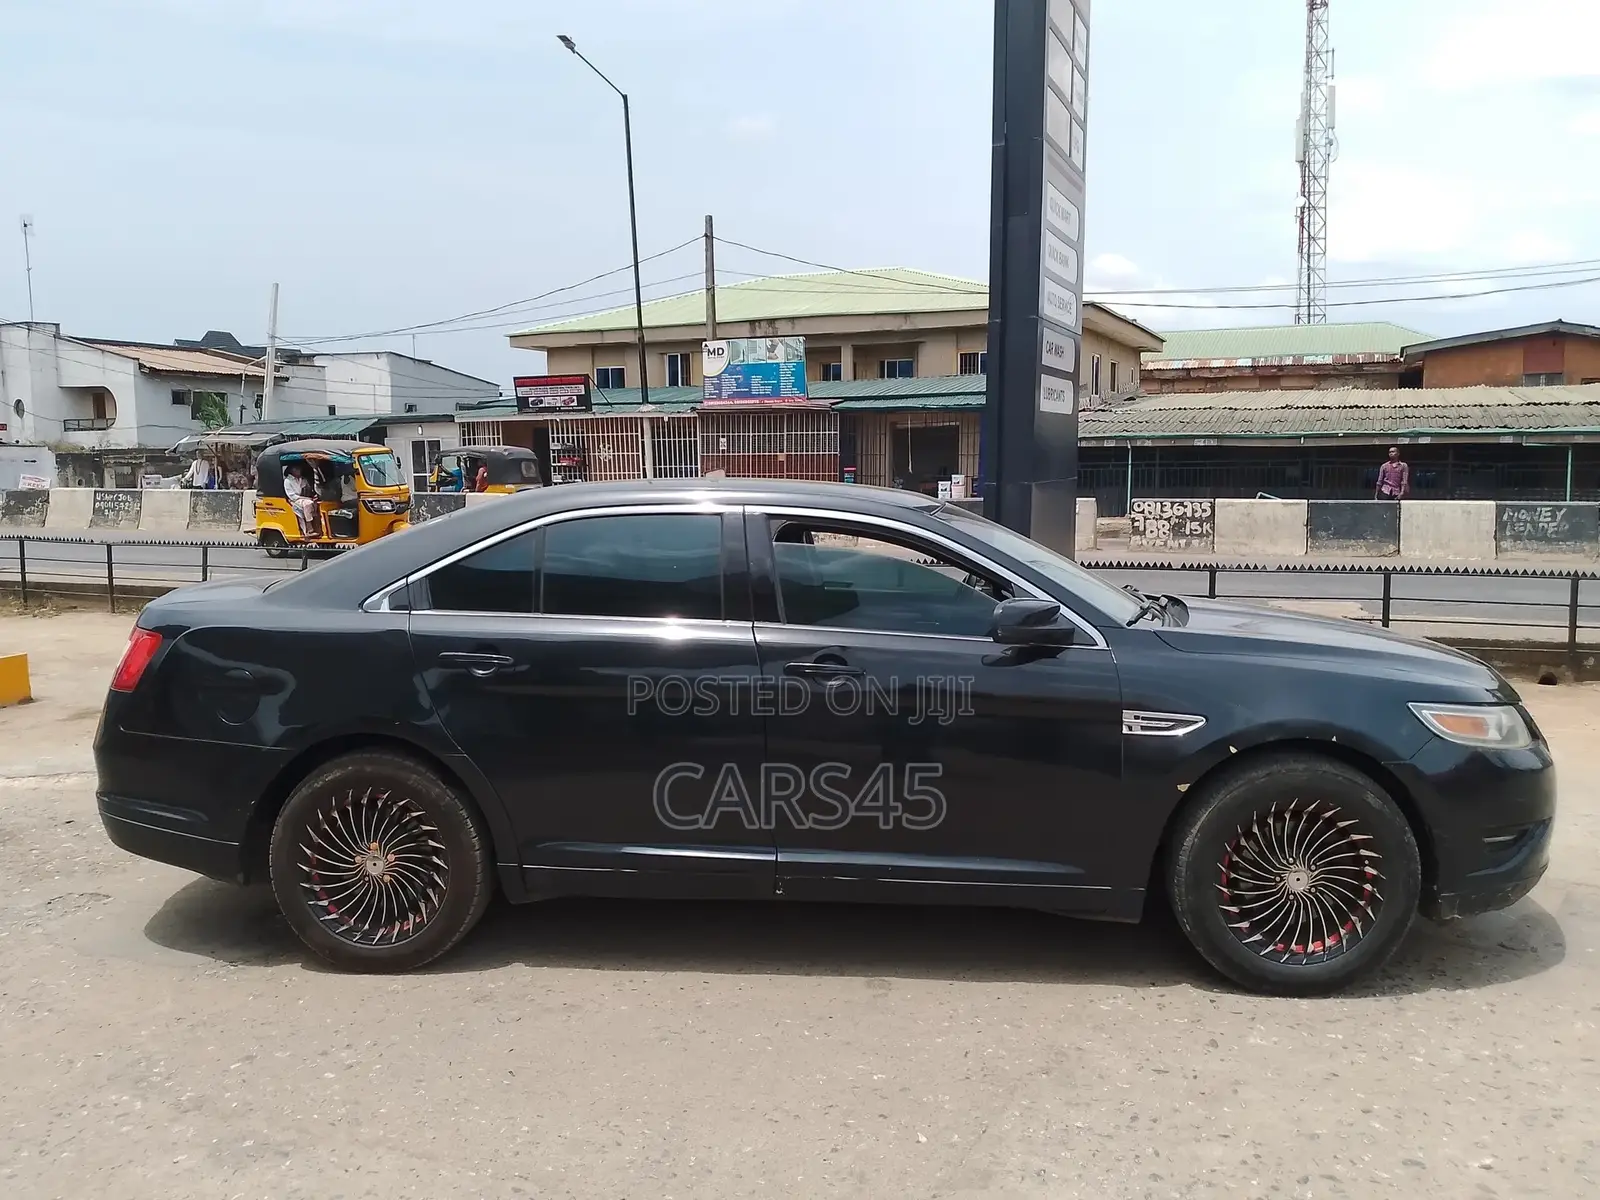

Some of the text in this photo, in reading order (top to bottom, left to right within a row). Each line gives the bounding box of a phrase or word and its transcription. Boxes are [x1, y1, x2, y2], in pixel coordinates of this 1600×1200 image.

[707, 347, 725, 357] MD
[1045, 340, 1065, 359] CAR WASH
[1043, 386, 1066, 403] LUBRICANTS
